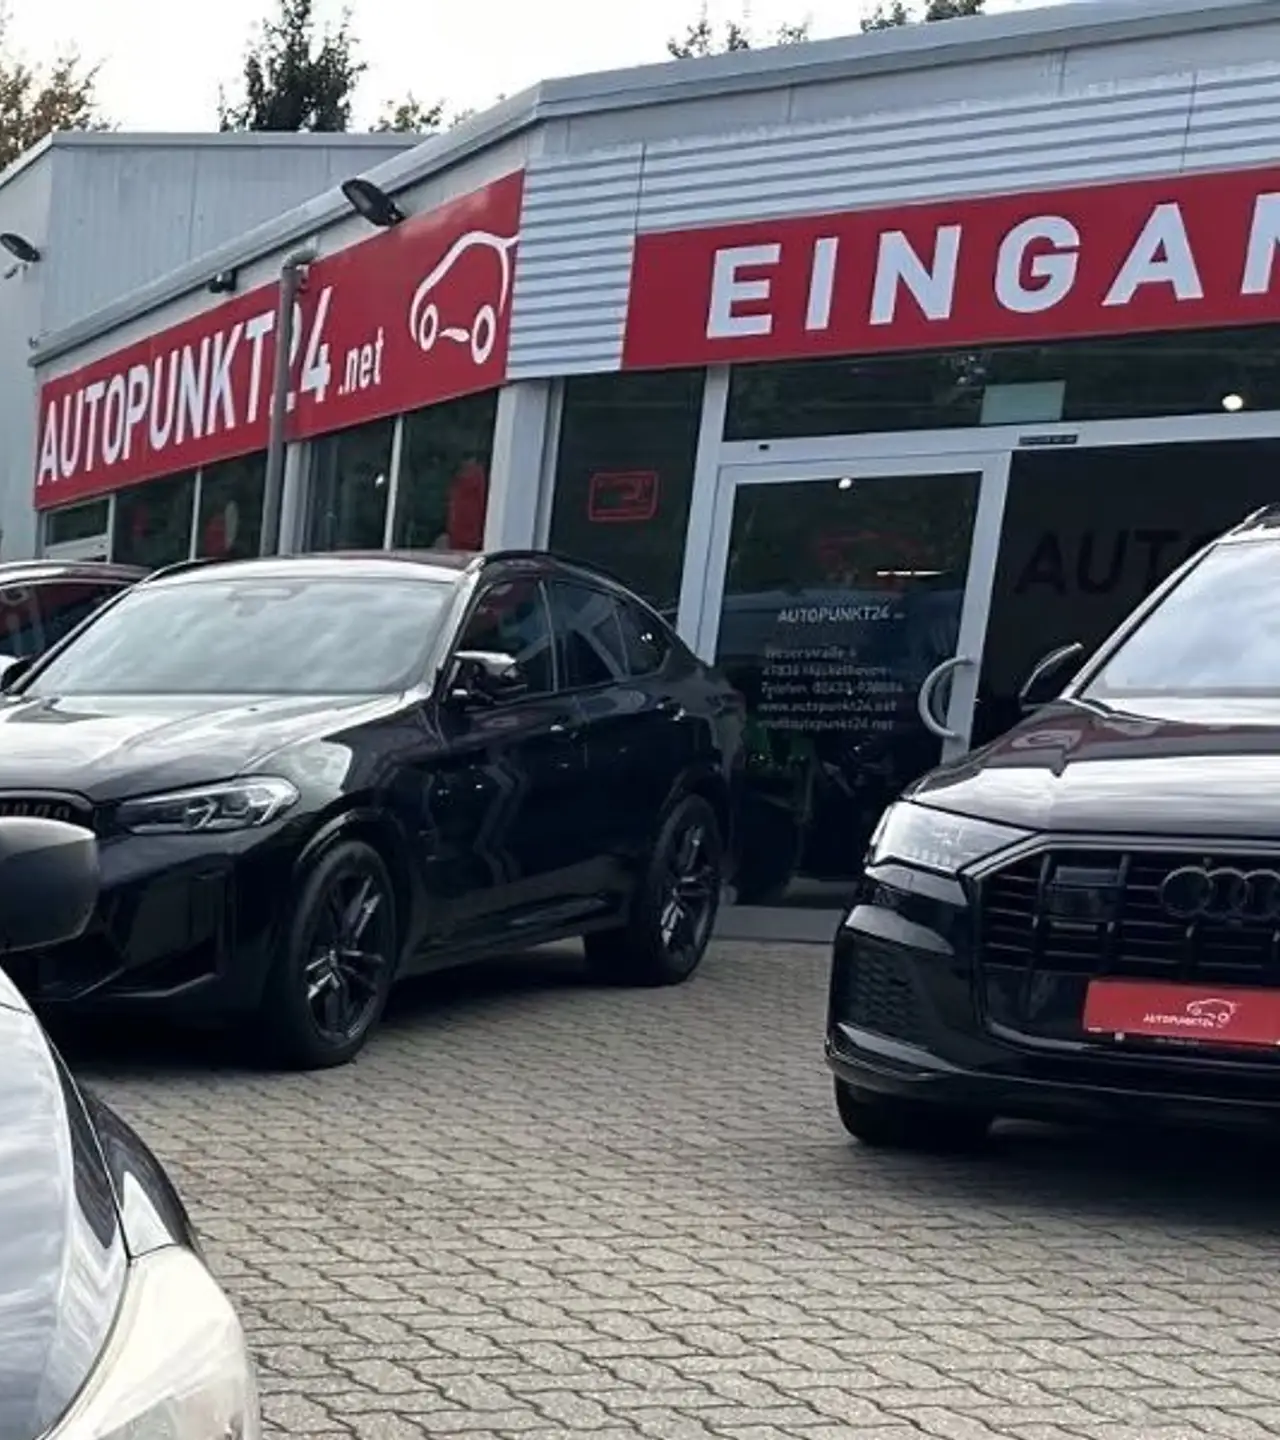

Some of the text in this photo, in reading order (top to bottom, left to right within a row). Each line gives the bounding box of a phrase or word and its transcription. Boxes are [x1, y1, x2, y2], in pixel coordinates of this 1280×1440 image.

[337, 325, 384, 396] .net
[1014, 529, 1216, 596] AUT
[777, 603, 891, 623] AUTOPUNKT24
